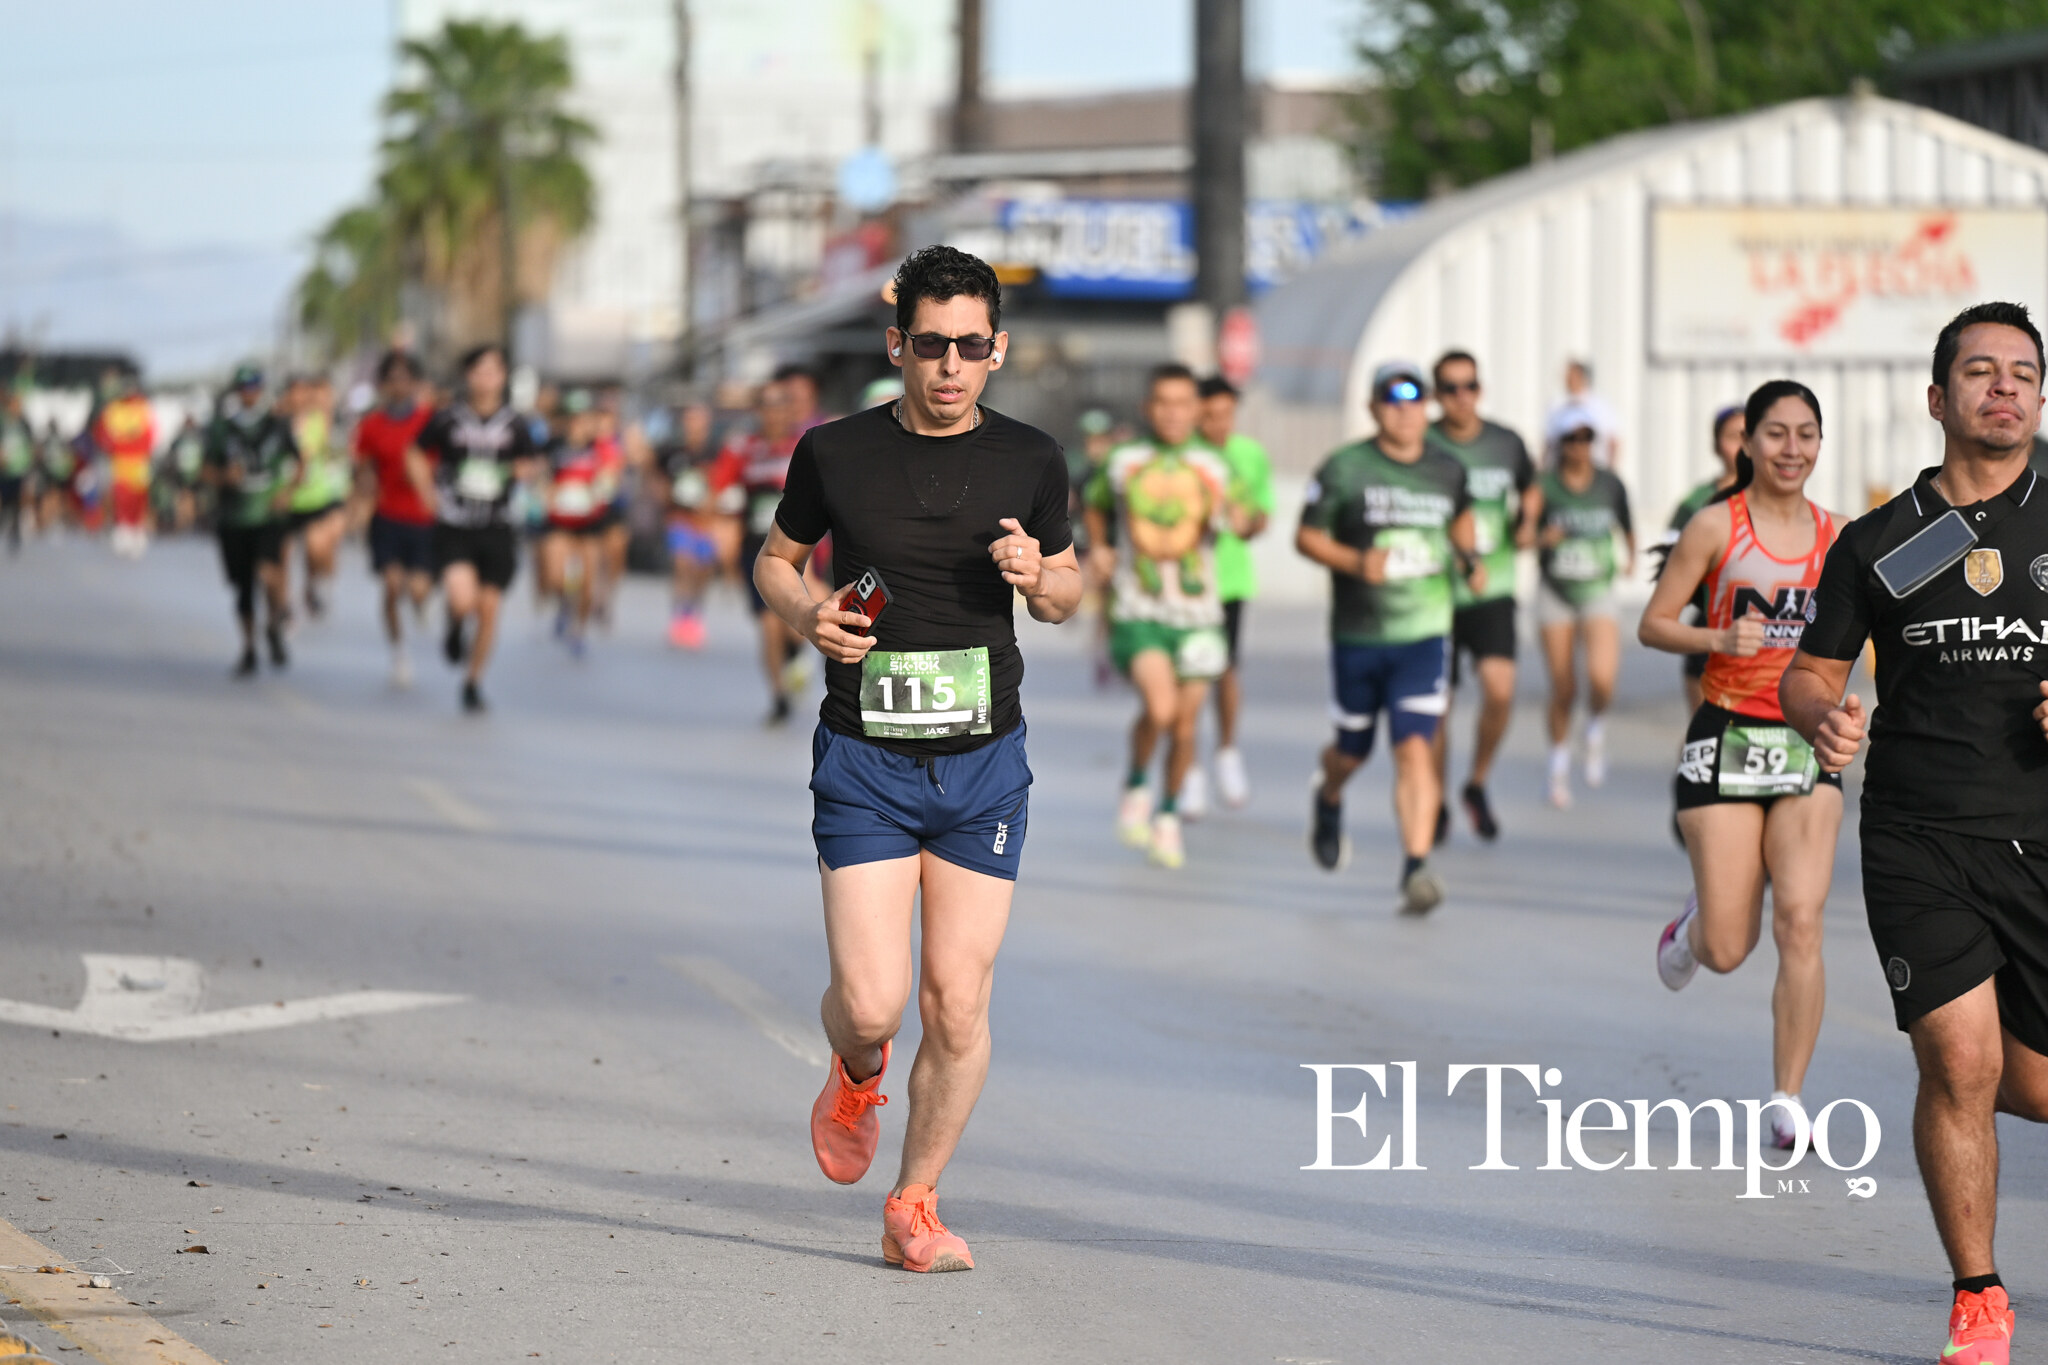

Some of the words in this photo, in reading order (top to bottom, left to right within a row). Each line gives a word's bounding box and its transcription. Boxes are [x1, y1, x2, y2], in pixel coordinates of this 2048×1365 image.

[973, 654, 987, 662] 115
[1939, 646, 2035, 663] AIRWAYS
[877, 676, 957, 711] 115
[977, 667, 988, 724] MEDALLA
[1744, 746, 1789, 775] 59
